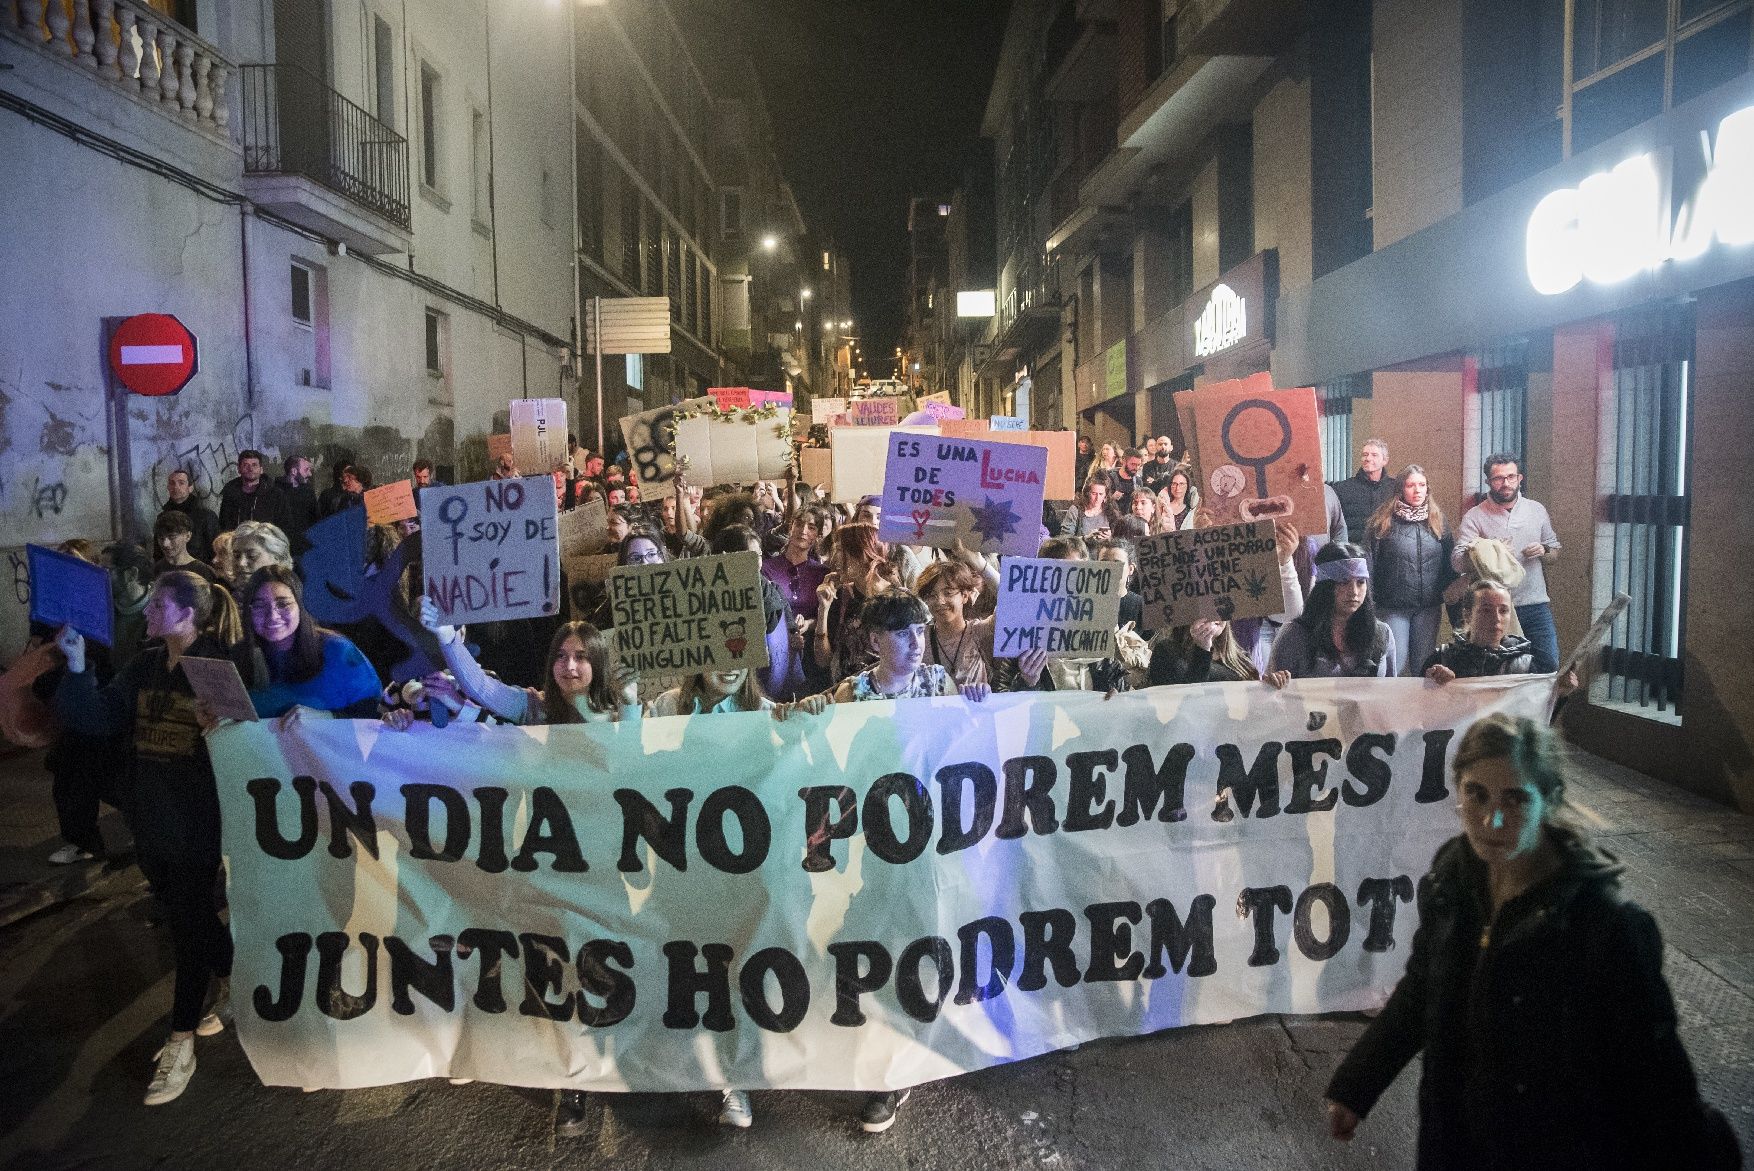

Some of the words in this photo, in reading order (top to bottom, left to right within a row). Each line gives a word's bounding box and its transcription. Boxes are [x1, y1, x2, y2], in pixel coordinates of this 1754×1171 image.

[897, 441, 920, 458] ES
[937, 443, 978, 463] UNA
[914, 466, 942, 484] DE
[485, 482, 525, 513] NO
[896, 486, 956, 508] TODES
[468, 520, 512, 546] SOY
[525, 517, 556, 540] DE
[1139, 539, 1157, 556] SI
[1160, 534, 1184, 553] TE
[1193, 522, 1257, 547] ACOSAN
[1139, 549, 1200, 574] PRENDE
[1205, 545, 1226, 561] UN
[1227, 538, 1277, 558] PORRO
[1197, 557, 1242, 580] VIENE
[612, 571, 674, 600] FELIZ
[676, 565, 707, 591] VA
[712, 562, 730, 587] A
[1008, 564, 1063, 595] PELEO
[1065, 566, 1112, 596] COMO
[614, 596, 658, 626] SER
[660, 593, 684, 620] EL
[688, 589, 721, 616] DIA
[721, 586, 758, 613] QUE
[1036, 594, 1094, 622] NIÑA
[1143, 586, 1165, 605] LA
[618, 625, 644, 652] NO
[649, 618, 712, 647] FALTE
[1046, 626, 1109, 652] ENCANTA
[620, 645, 716, 671] NINGUNA
[246, 775, 380, 861] UN
[400, 783, 590, 874] DIA
[613, 784, 773, 875] NO
[797, 742, 1195, 873] PODREM
[1211, 711, 1396, 822] MÉS
[1414, 729, 1455, 804] I
[252, 927, 637, 1028] JUNTES
[662, 939, 811, 1034] HO
[827, 893, 1218, 1028] PODREM
[1235, 874, 1415, 967] TOT
